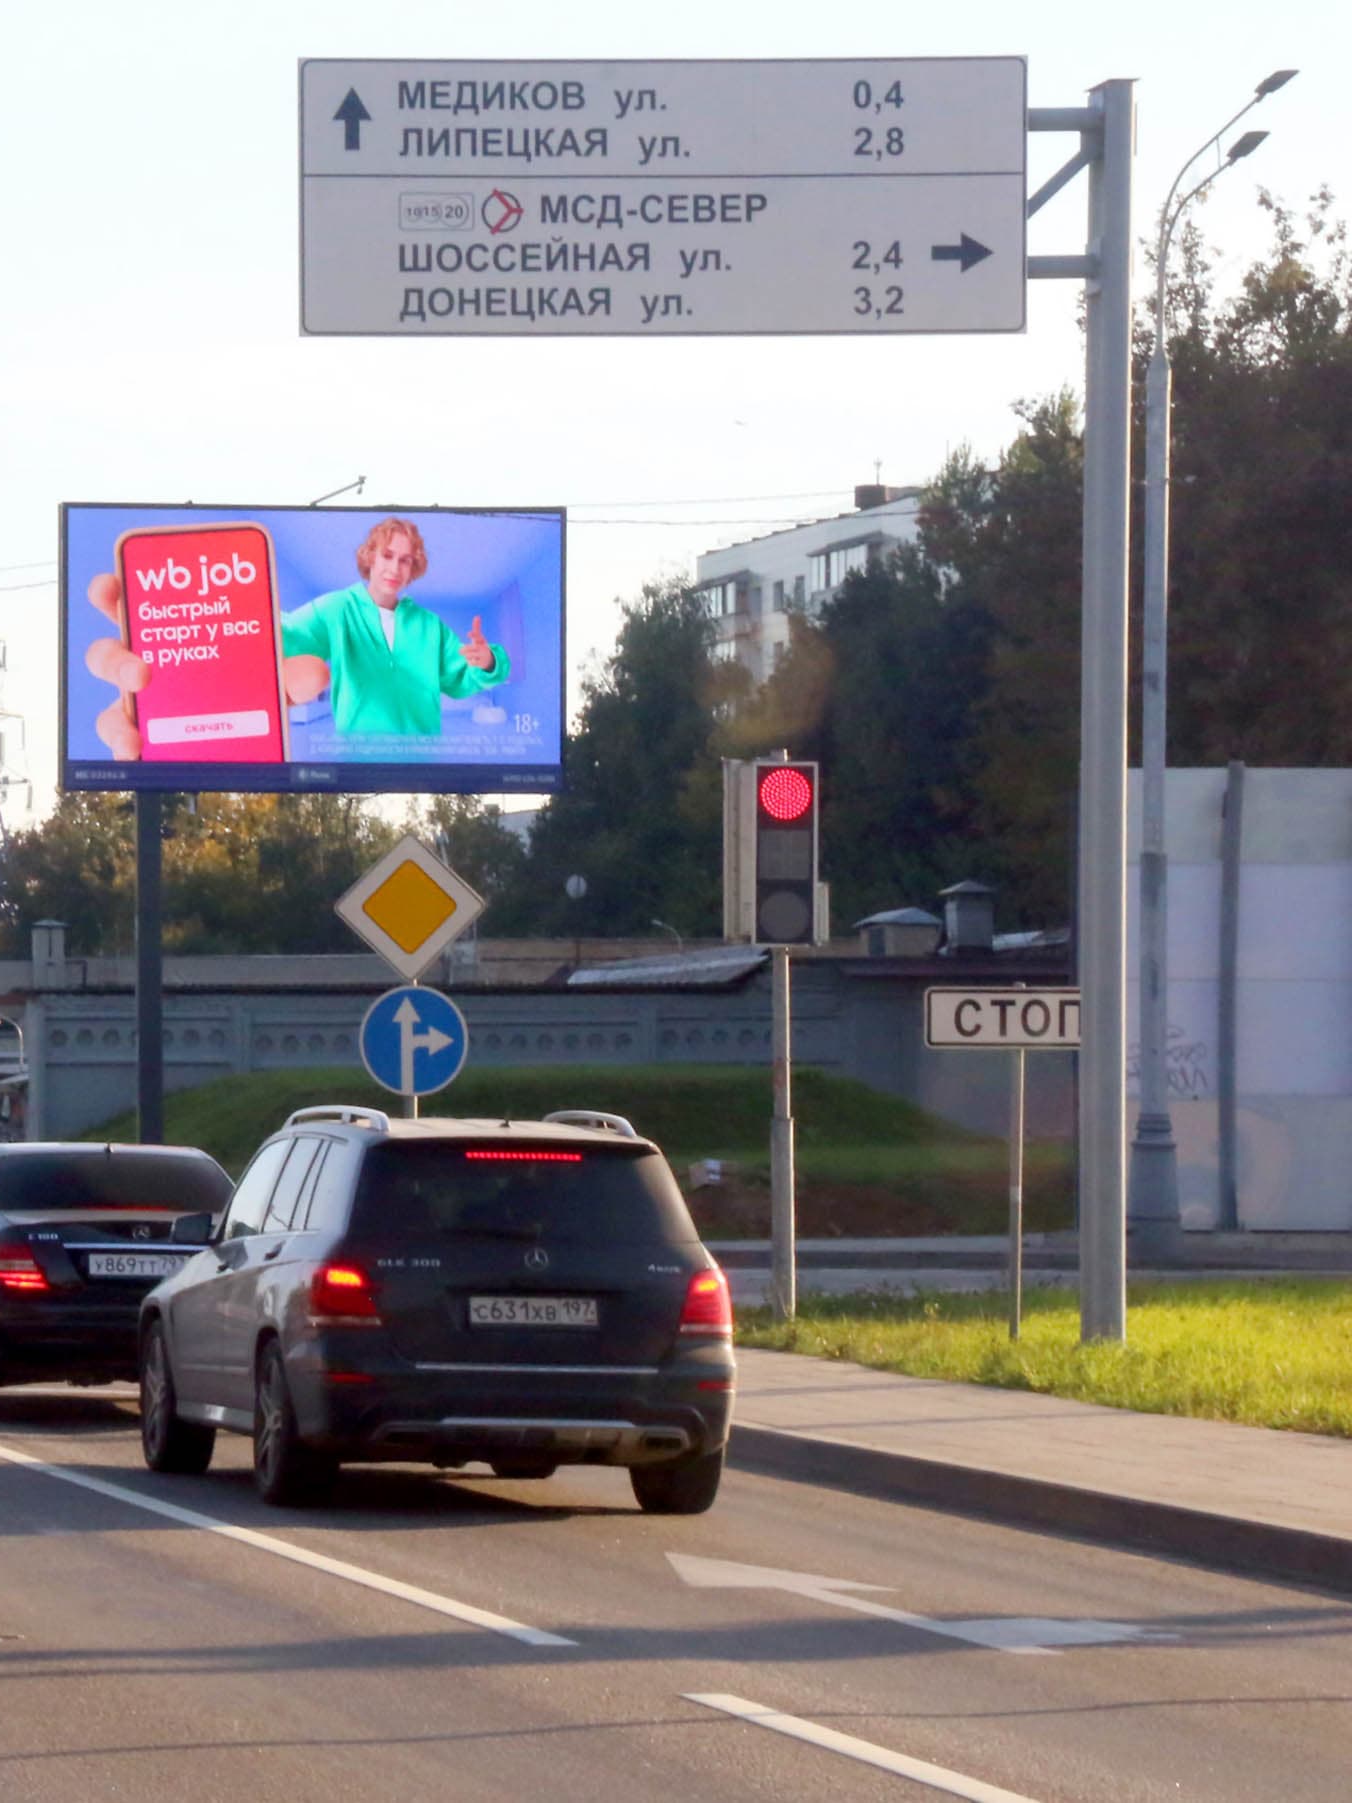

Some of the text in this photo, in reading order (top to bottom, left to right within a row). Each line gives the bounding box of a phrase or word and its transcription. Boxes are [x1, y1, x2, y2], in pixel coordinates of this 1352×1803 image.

[399, 79, 905, 119] МЕДИКОВ ул. 0,4
[399, 126, 905, 165] ЛИПЕЦКАЯ ул. 2,8
[445, 205, 464, 219] 20
[540, 194, 767, 226] МСД-СЕВЕР
[399, 237, 904, 278] ШОССЕЙНАЯ ул. 2,4
[399, 285, 905, 324] ДОНЕЦКАЯ ул. 3,2
[135, 552, 257, 596] wb job
[138, 595, 231, 621] быстрый
[140, 620, 260, 644] старт у вас
[141, 645, 220, 668] в руках
[184, 722, 234, 735] скачать
[514, 713, 540, 734] 18+
[954, 998, 1081, 1038] СТОП
